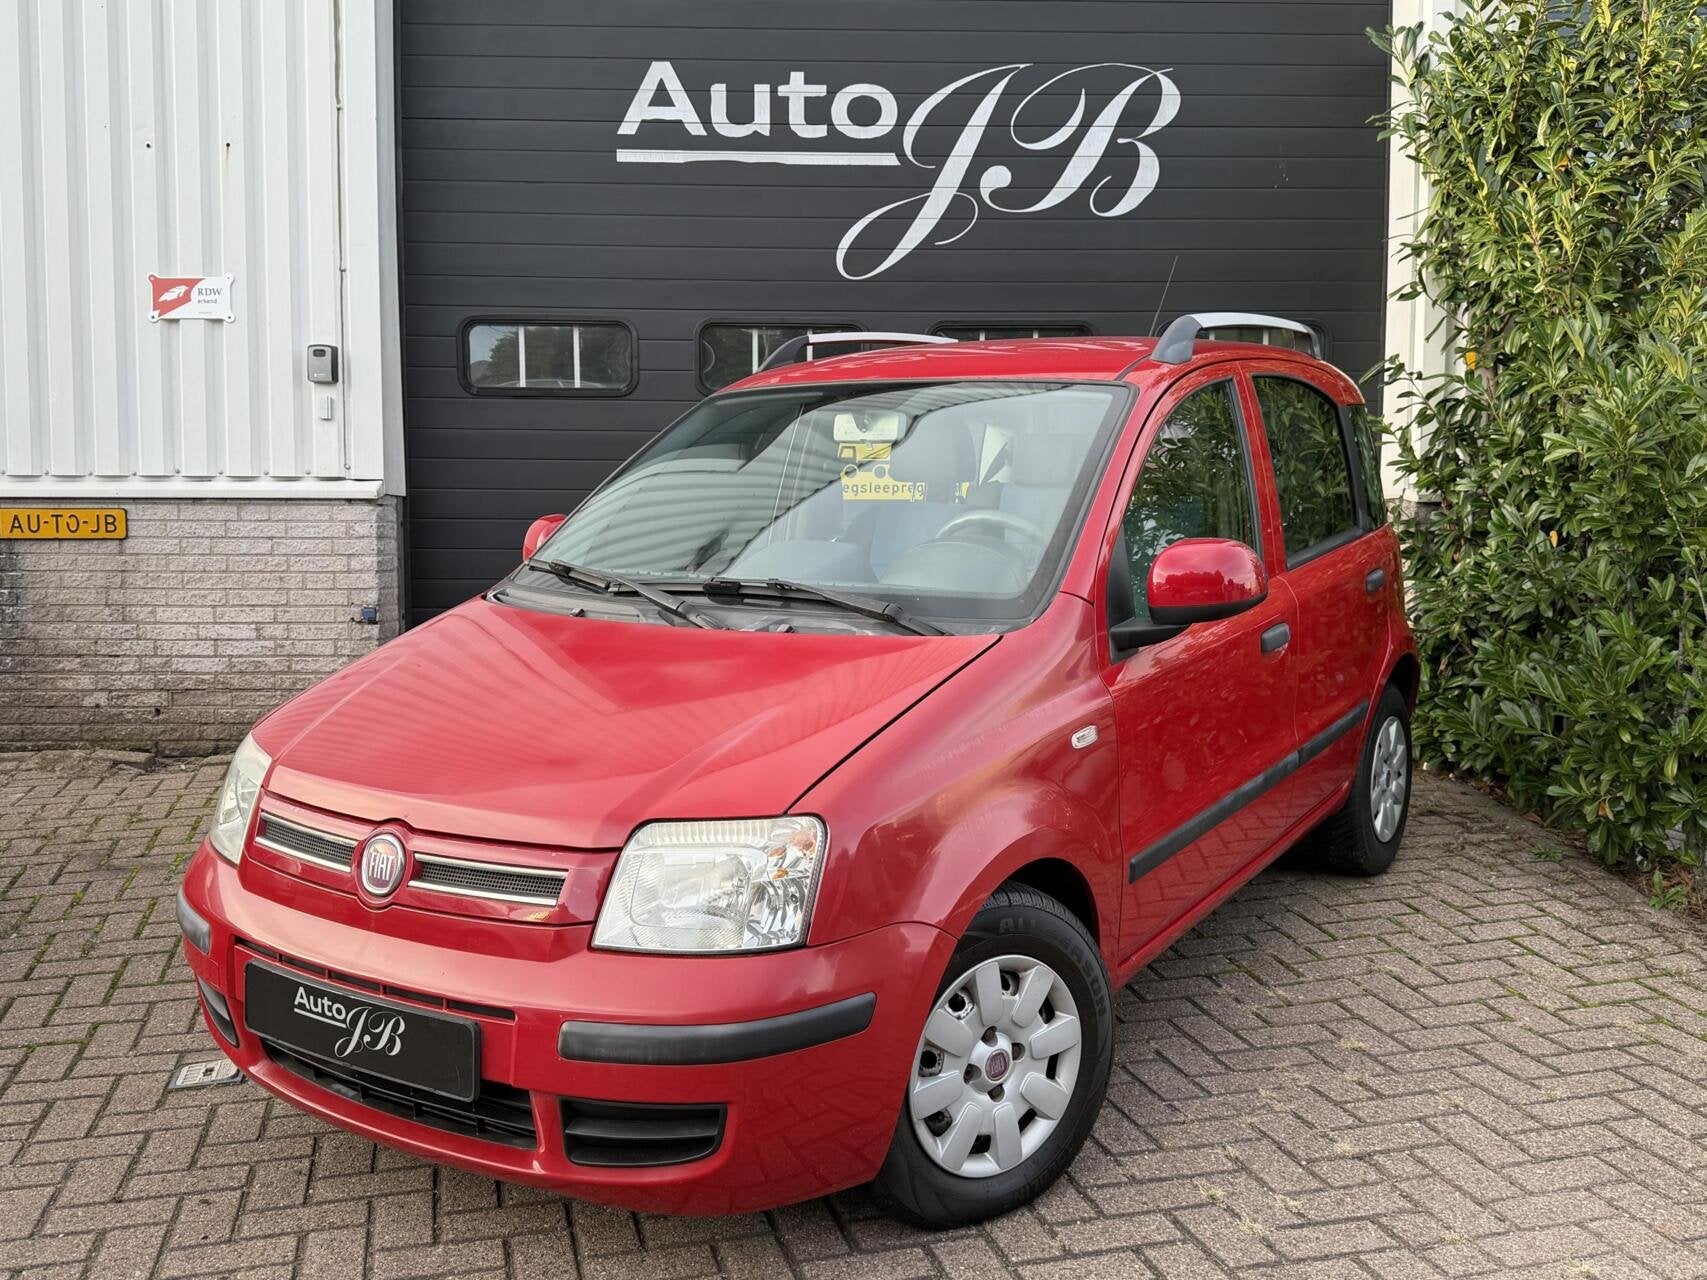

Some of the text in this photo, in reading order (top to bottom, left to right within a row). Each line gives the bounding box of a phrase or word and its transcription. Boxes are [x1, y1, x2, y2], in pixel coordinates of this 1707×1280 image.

[617, 61, 1181, 280] Auto JB
[197, 287, 222, 297] RDW
[9, 514, 118, 533] AU-TO-JB
[369, 852, 395, 881] FIAT
[294, 986, 406, 1058] Auto JB
